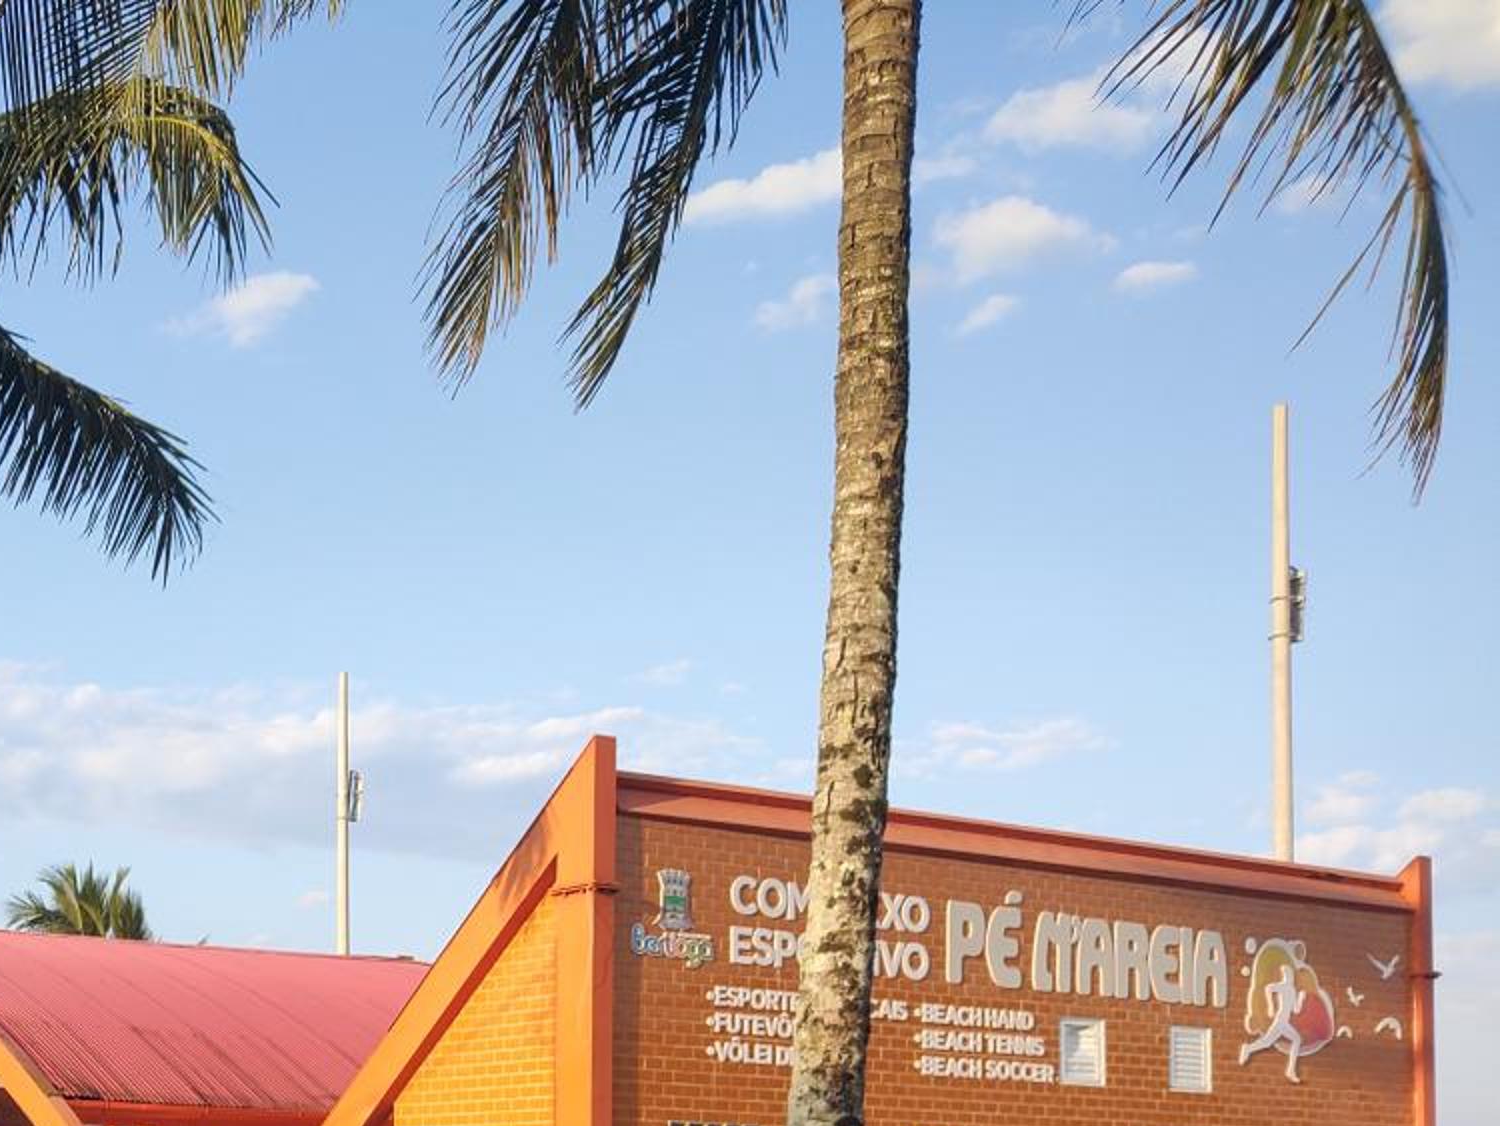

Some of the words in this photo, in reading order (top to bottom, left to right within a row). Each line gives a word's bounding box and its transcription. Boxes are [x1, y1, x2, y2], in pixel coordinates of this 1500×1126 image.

[730, 875, 930, 933] COMXO
[729, 926, 930, 981] ESPIVO
[945, 890, 1022, 988] PÉ
[921, 1003, 982, 1027] BEACH
[984, 1007, 1035, 1031] HAND
[921, 1029, 982, 1053] BEACH
[984, 1034, 1046, 1057] TENNIS
[921, 1055, 982, 1079] BEACH
